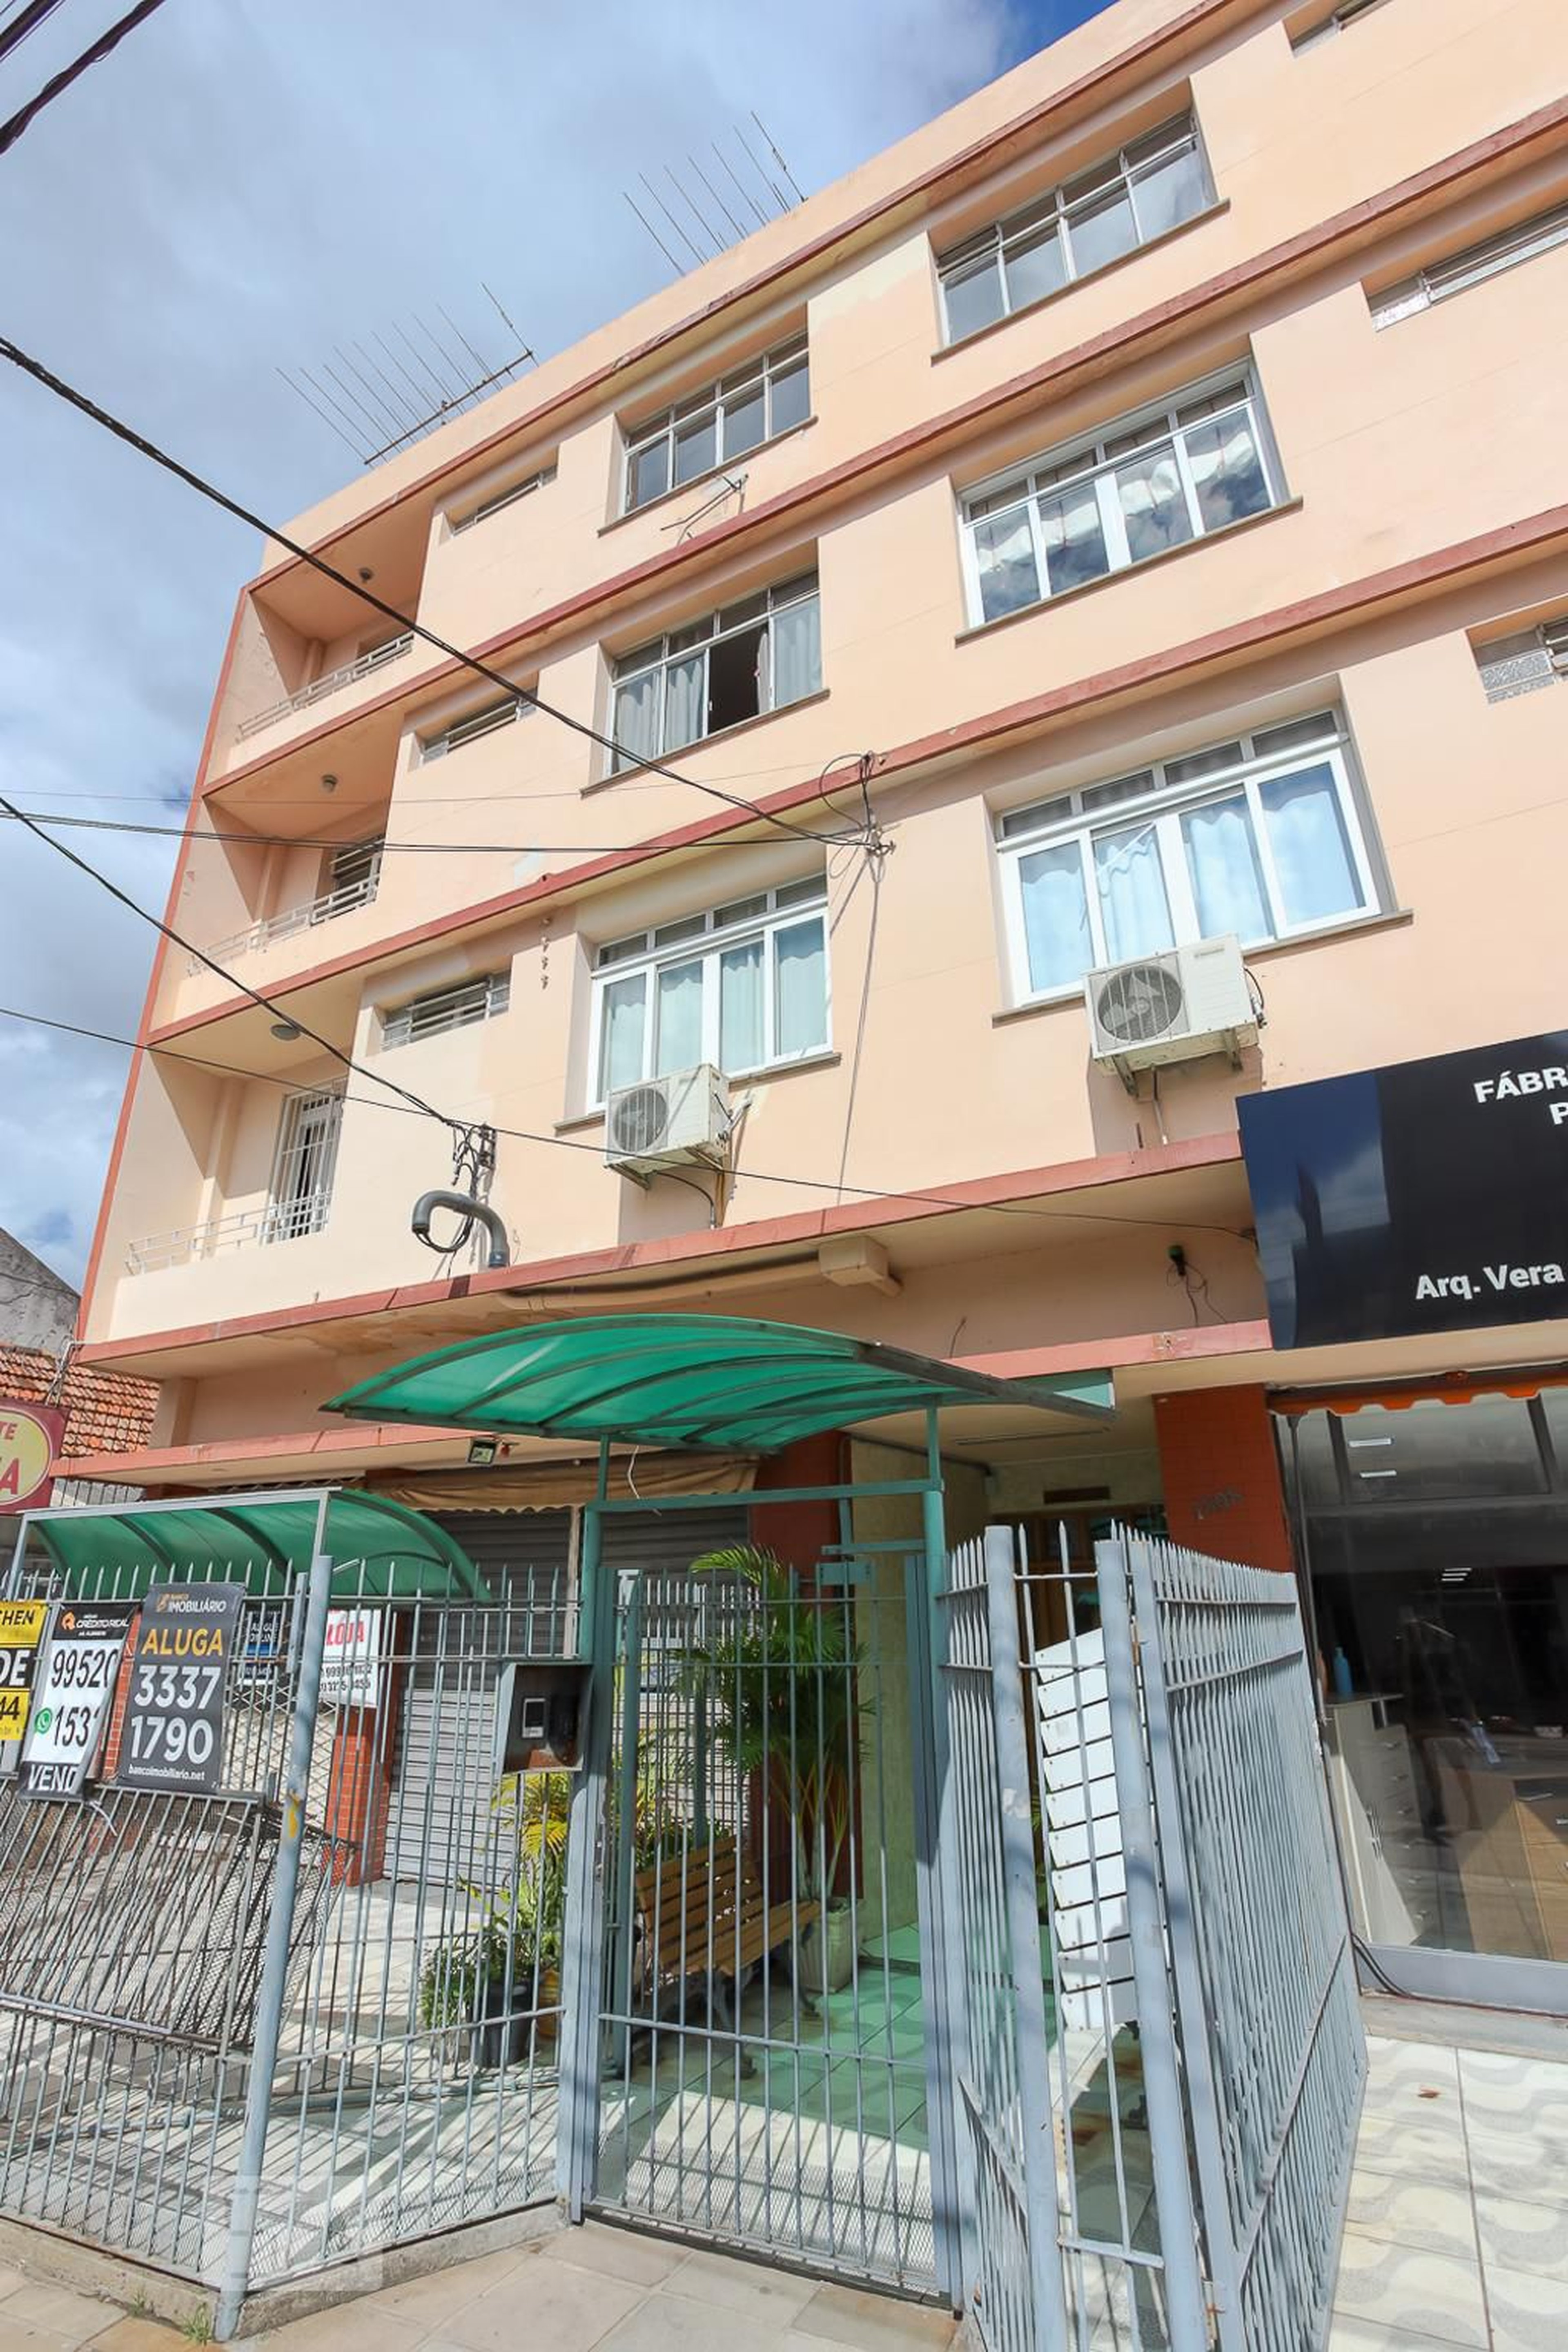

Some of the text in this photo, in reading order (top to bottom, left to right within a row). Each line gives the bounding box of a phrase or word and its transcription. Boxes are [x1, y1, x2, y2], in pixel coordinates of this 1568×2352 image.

[1474, 1066, 1568, 1103] FÁBR
[1416, 1263, 1565, 1300] Arq. Vera
[0, 1610, 34, 1625] HEN
[168, 1597, 227, 1613] IMOBILIÁRIO
[141, 1628, 223, 1657] ALUGA
[134, 1665, 221, 1710] 3337
[55, 1705, 100, 1748] 153
[131, 1715, 214, 1764] 1790
